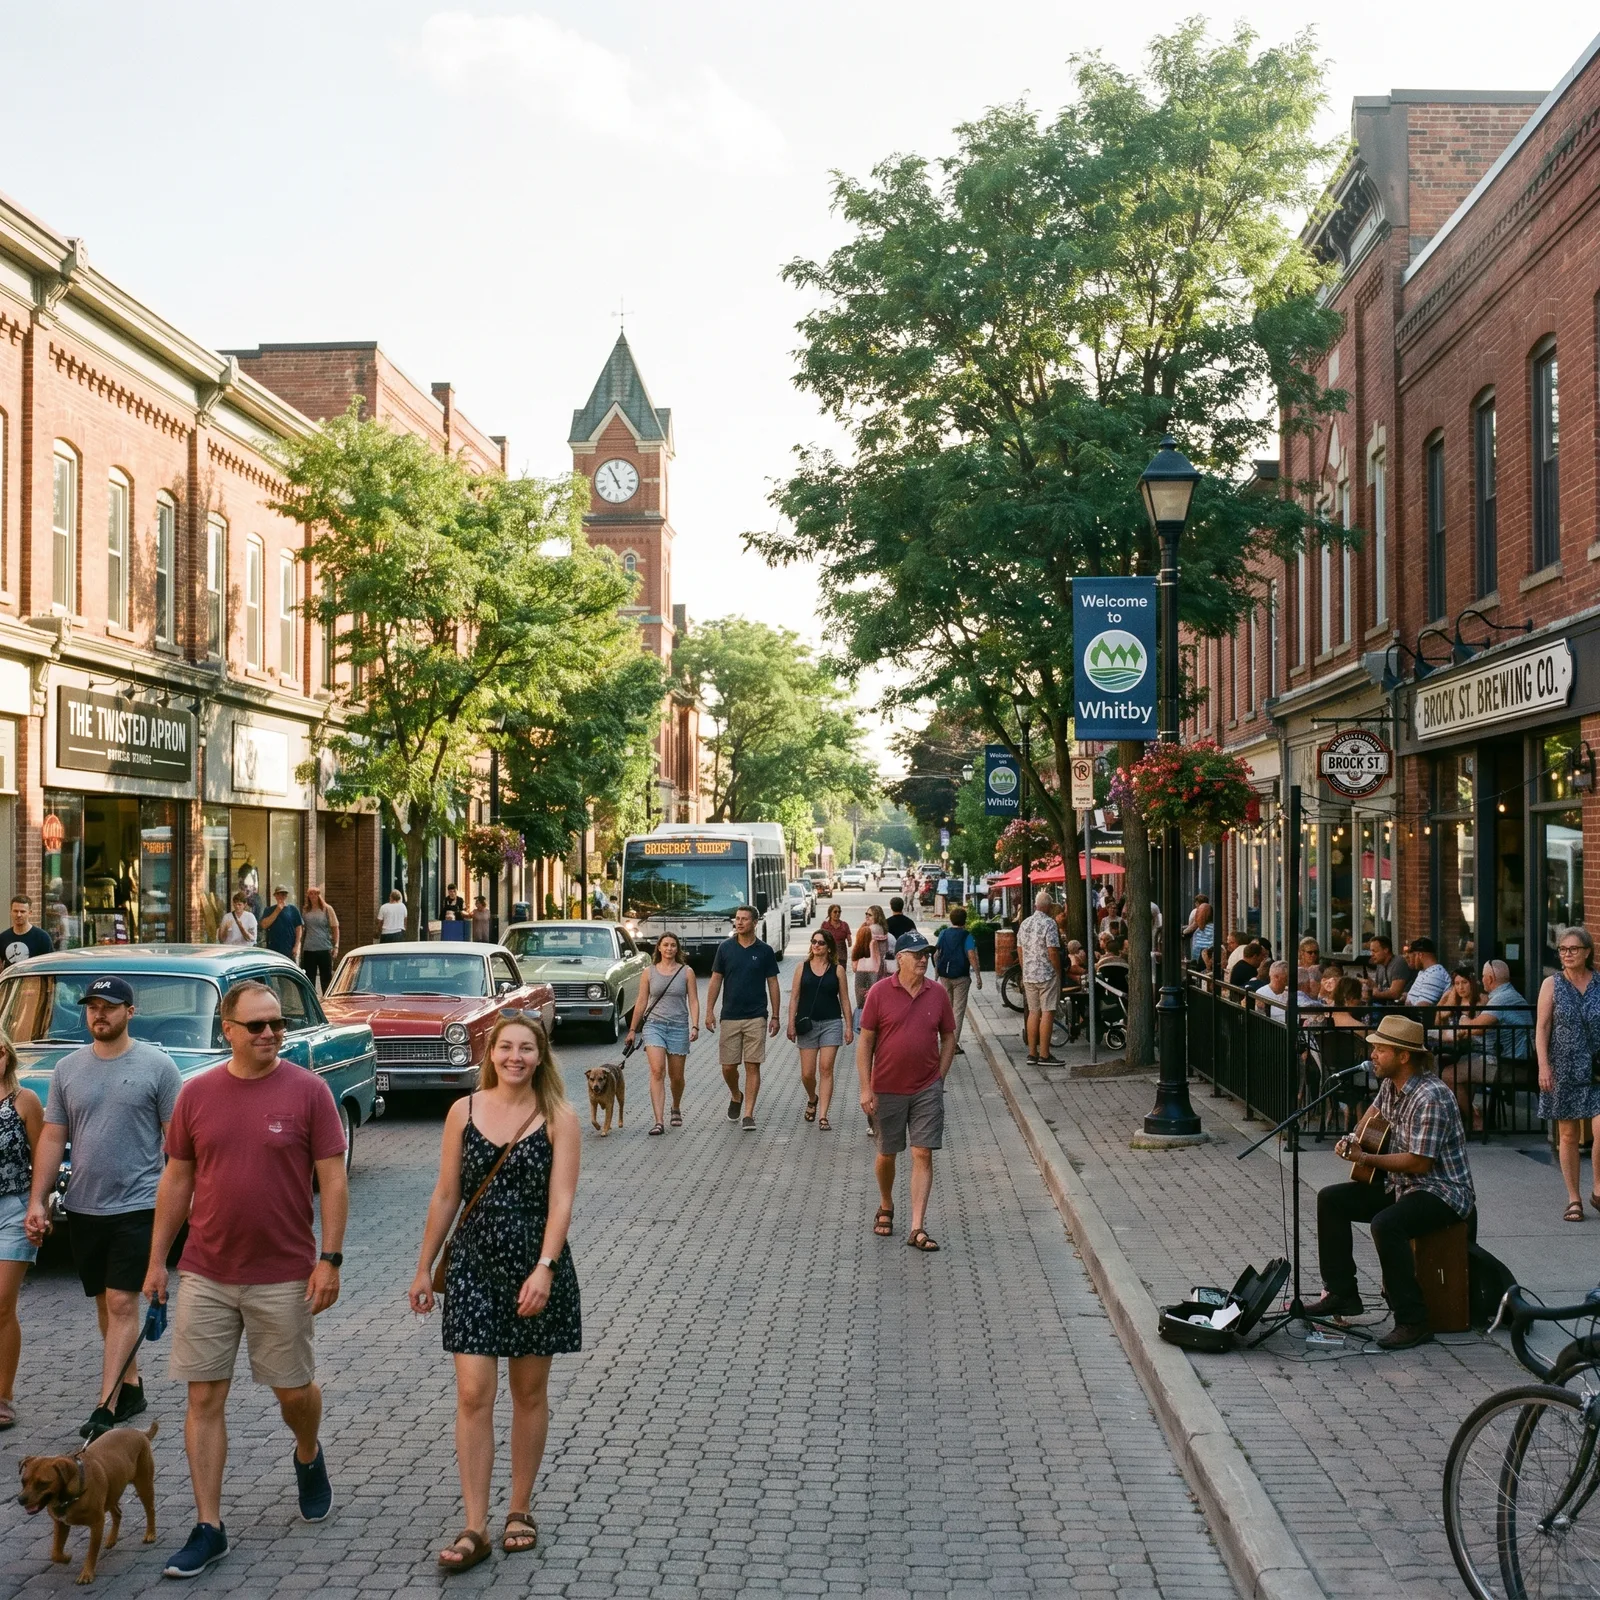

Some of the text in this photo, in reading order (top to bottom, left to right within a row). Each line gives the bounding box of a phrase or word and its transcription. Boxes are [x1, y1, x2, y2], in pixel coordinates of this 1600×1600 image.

[1081, 594, 1148, 608] Welcome
[1107, 611, 1122, 623] to
[1423, 655, 1558, 729] BROCK ST. BREWING CO.
[1078, 701, 1152, 724] Whitby
[68, 701, 186, 752] THE TWISTED APRON
[1328, 756, 1383, 770] BROCK ST.
[987, 797, 1019, 808] Whitby
